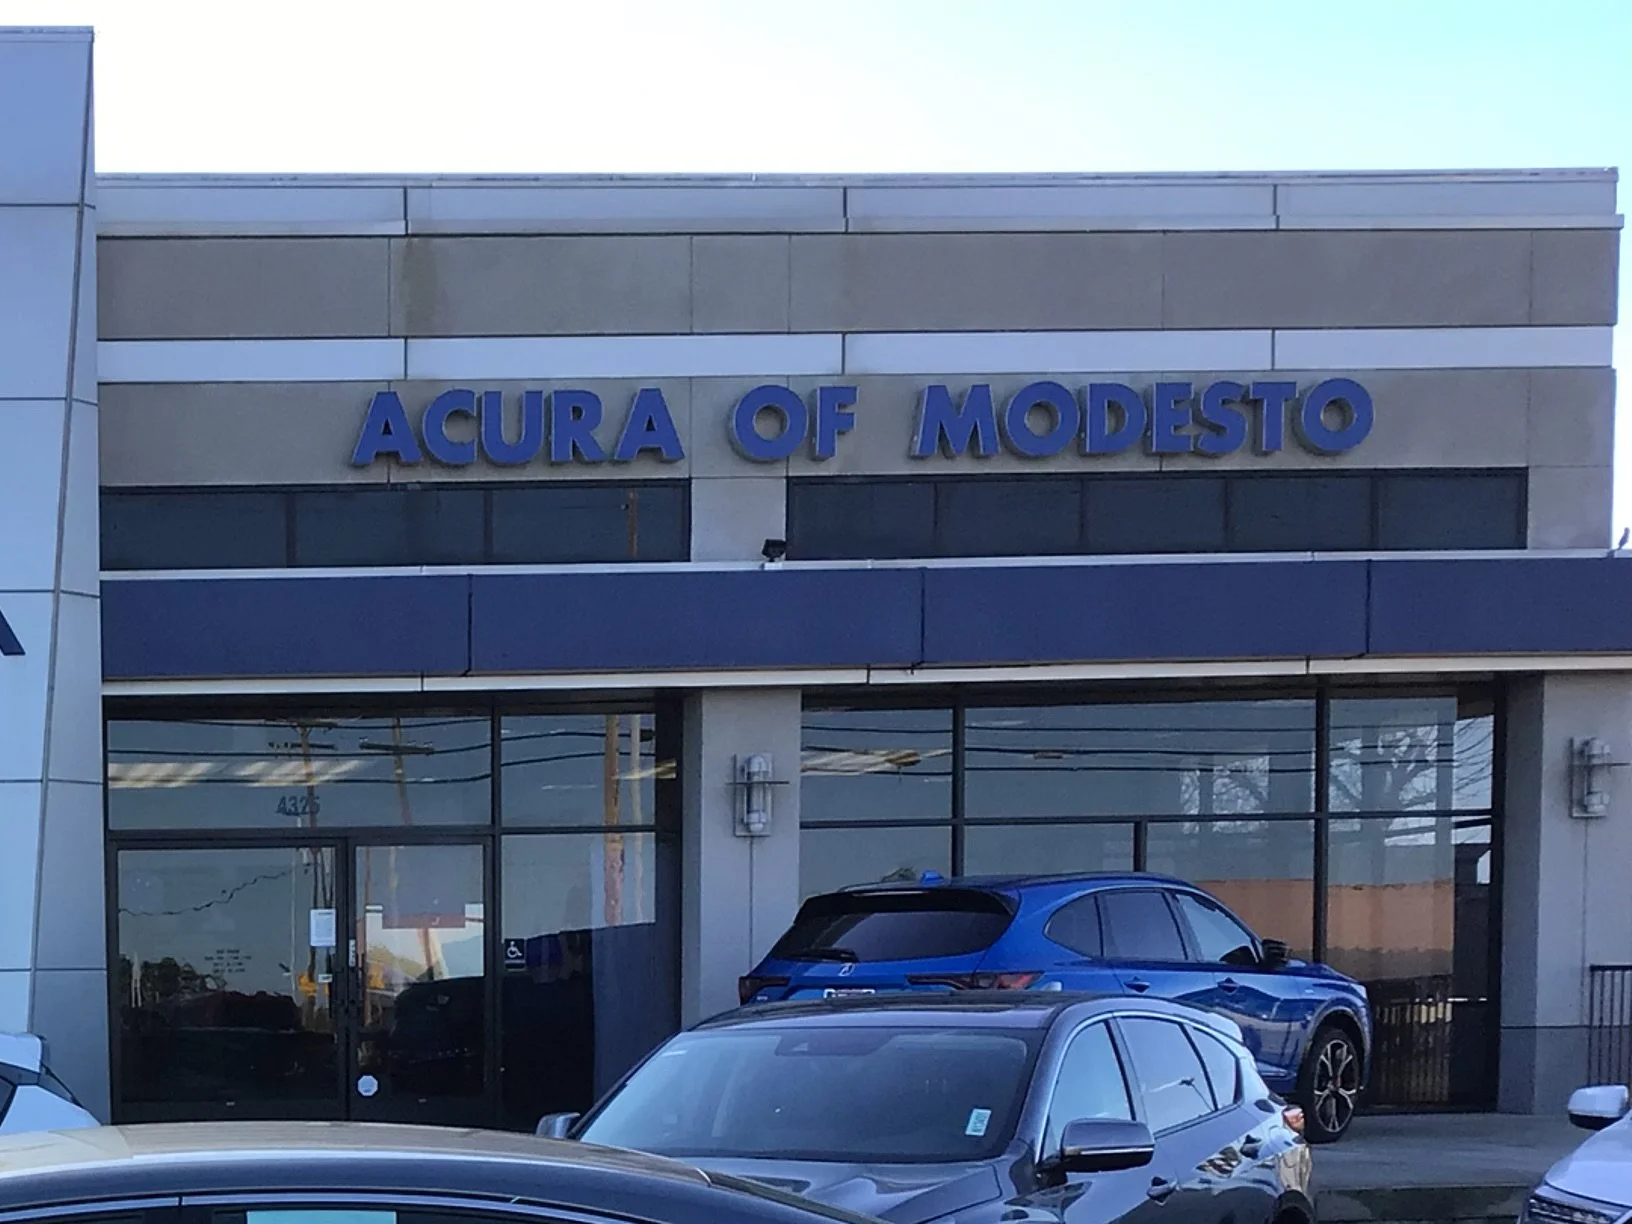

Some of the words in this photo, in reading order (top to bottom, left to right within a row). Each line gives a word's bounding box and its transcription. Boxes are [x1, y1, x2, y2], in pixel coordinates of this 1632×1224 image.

[352, 388, 686, 466] ACURA
[731, 384, 859, 462] OF
[911, 377, 1375, 458] MODESTO
